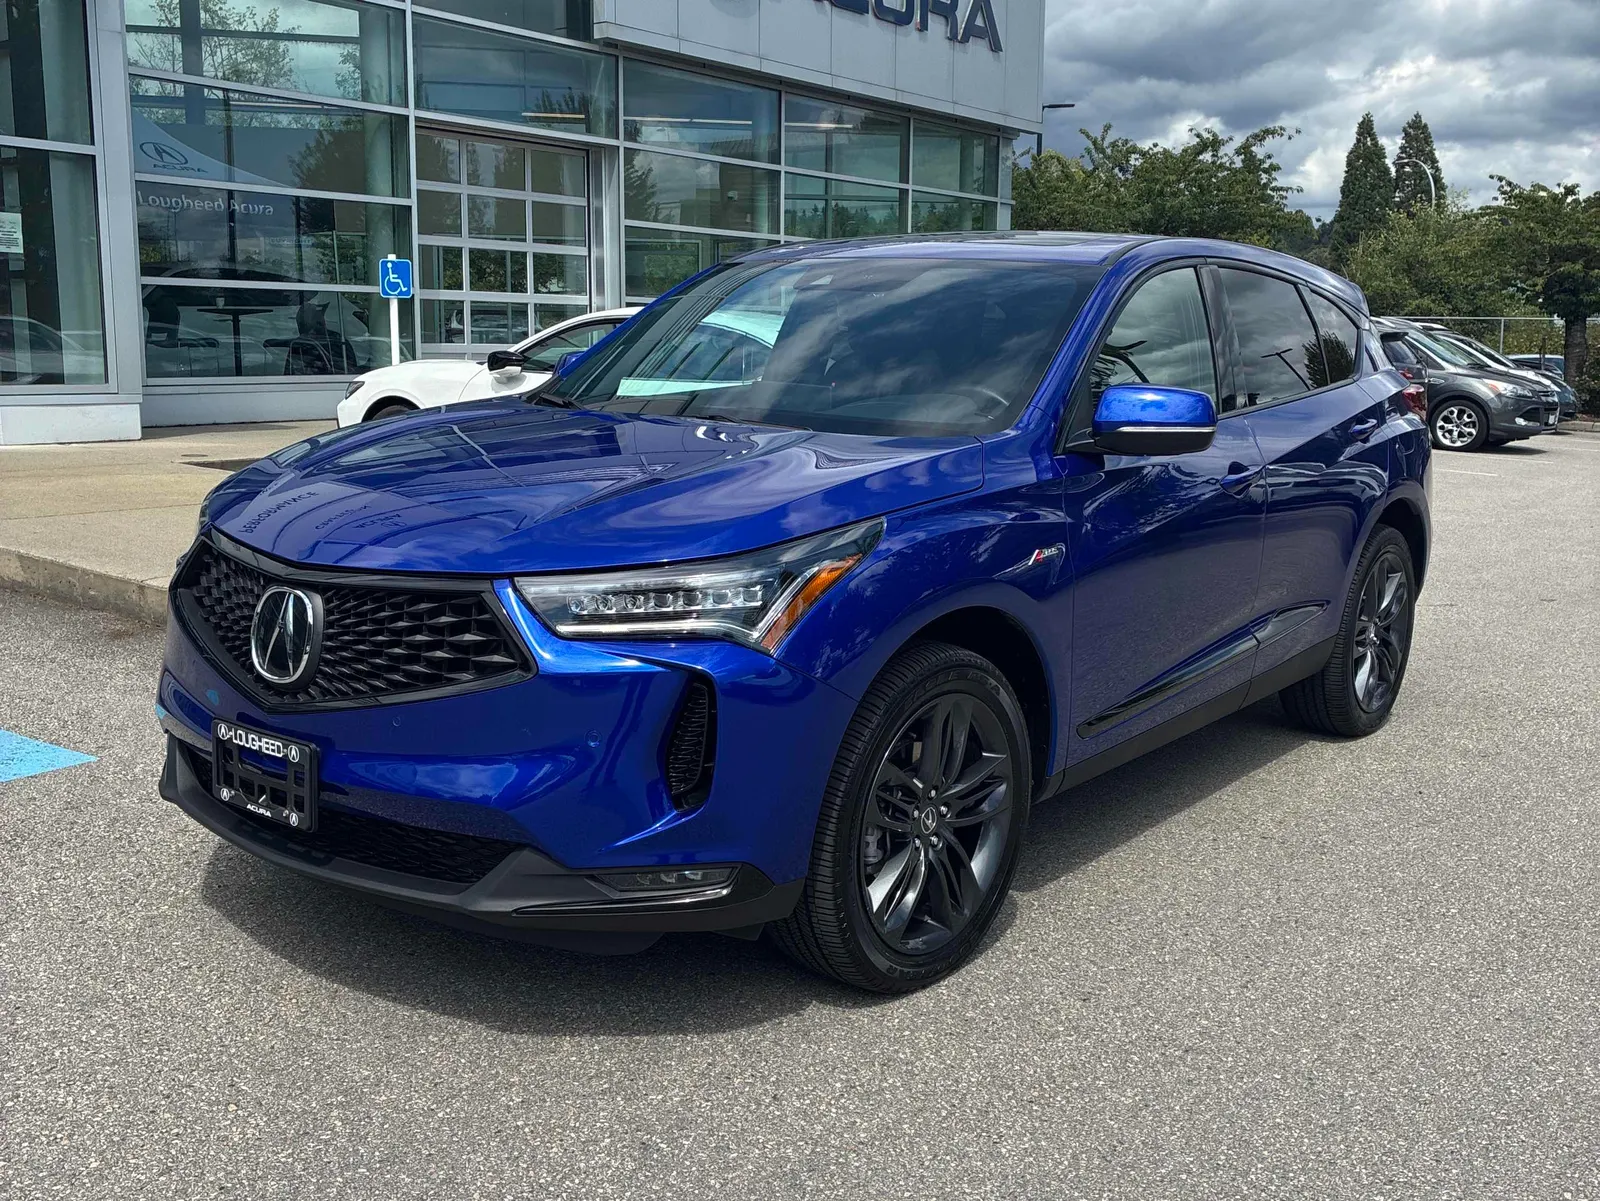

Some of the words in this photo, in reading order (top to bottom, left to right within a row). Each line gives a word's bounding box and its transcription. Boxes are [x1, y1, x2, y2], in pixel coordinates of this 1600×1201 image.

[137, 190, 225, 213] Lougheed
[229, 199, 274, 216] Acura
[232, 727, 283, 758] LOUGHEED
[246, 803, 272, 818] ACURA
